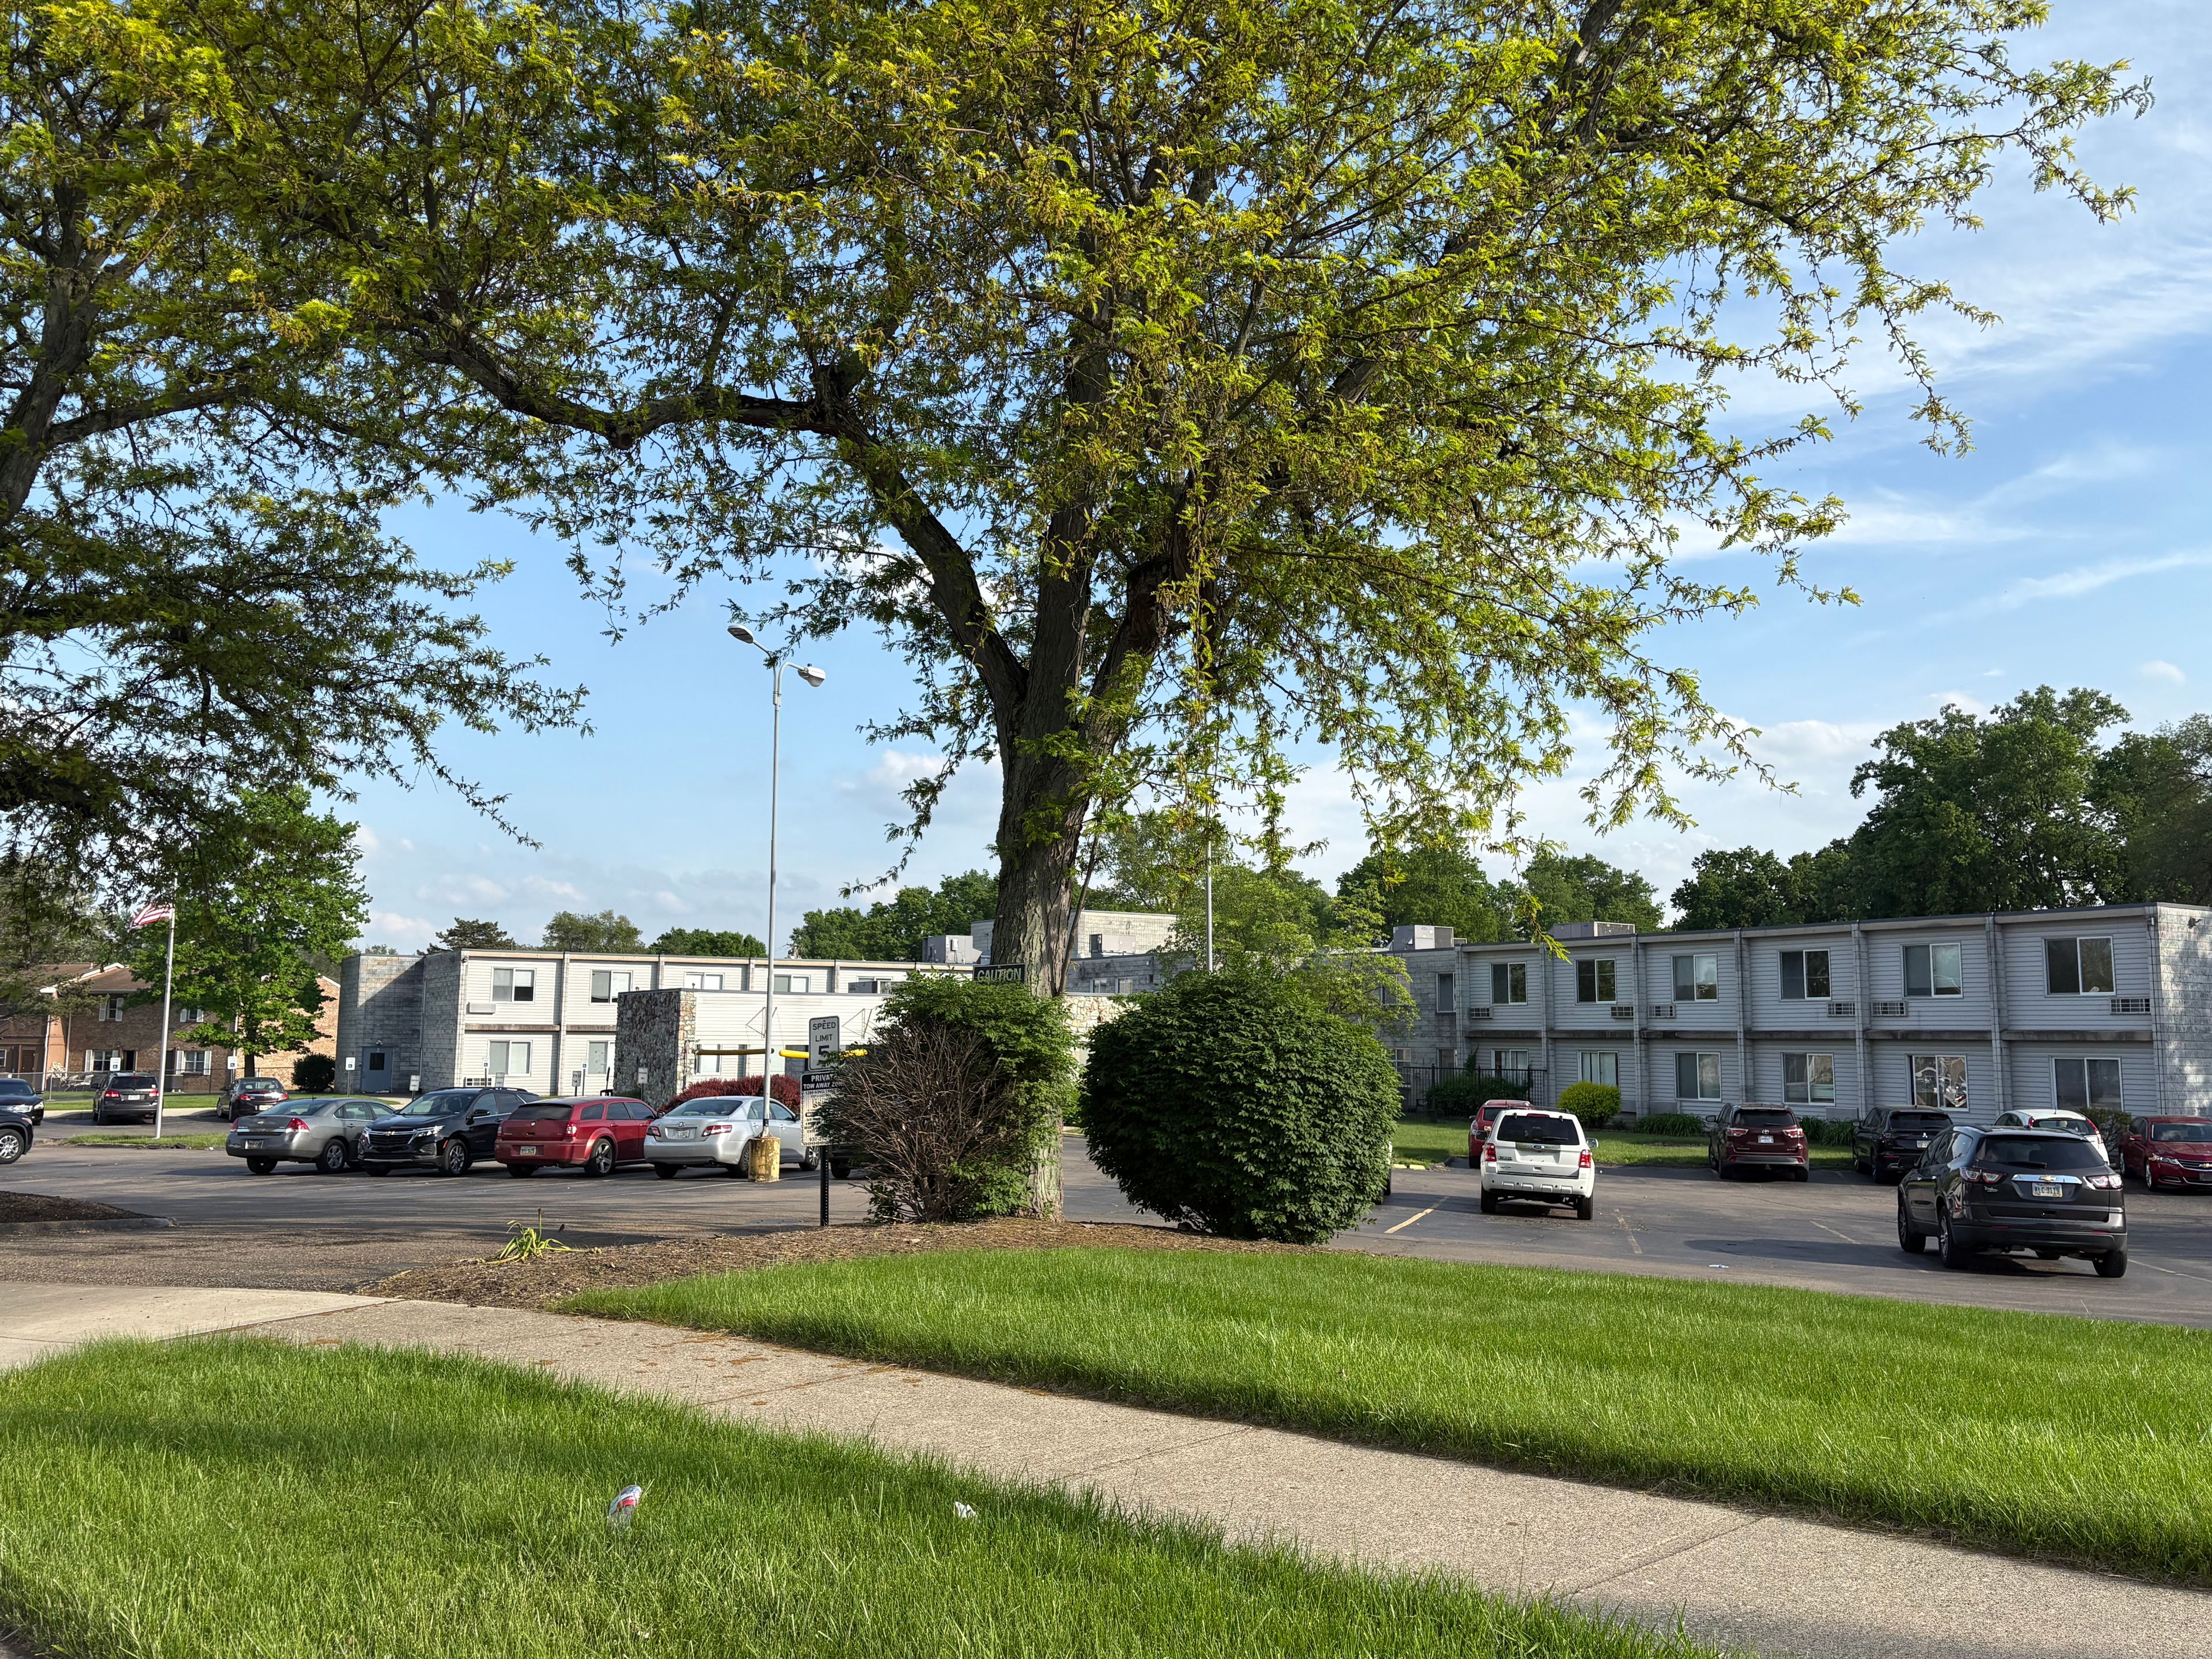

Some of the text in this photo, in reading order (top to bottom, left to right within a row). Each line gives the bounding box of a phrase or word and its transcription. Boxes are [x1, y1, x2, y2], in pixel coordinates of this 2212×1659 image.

[977, 968, 1021, 982] CAUTION
[812, 1022, 836, 1030] SPEED
[815, 1034, 833, 1042] LIMIT
[818, 1045, 830, 1064] 5
